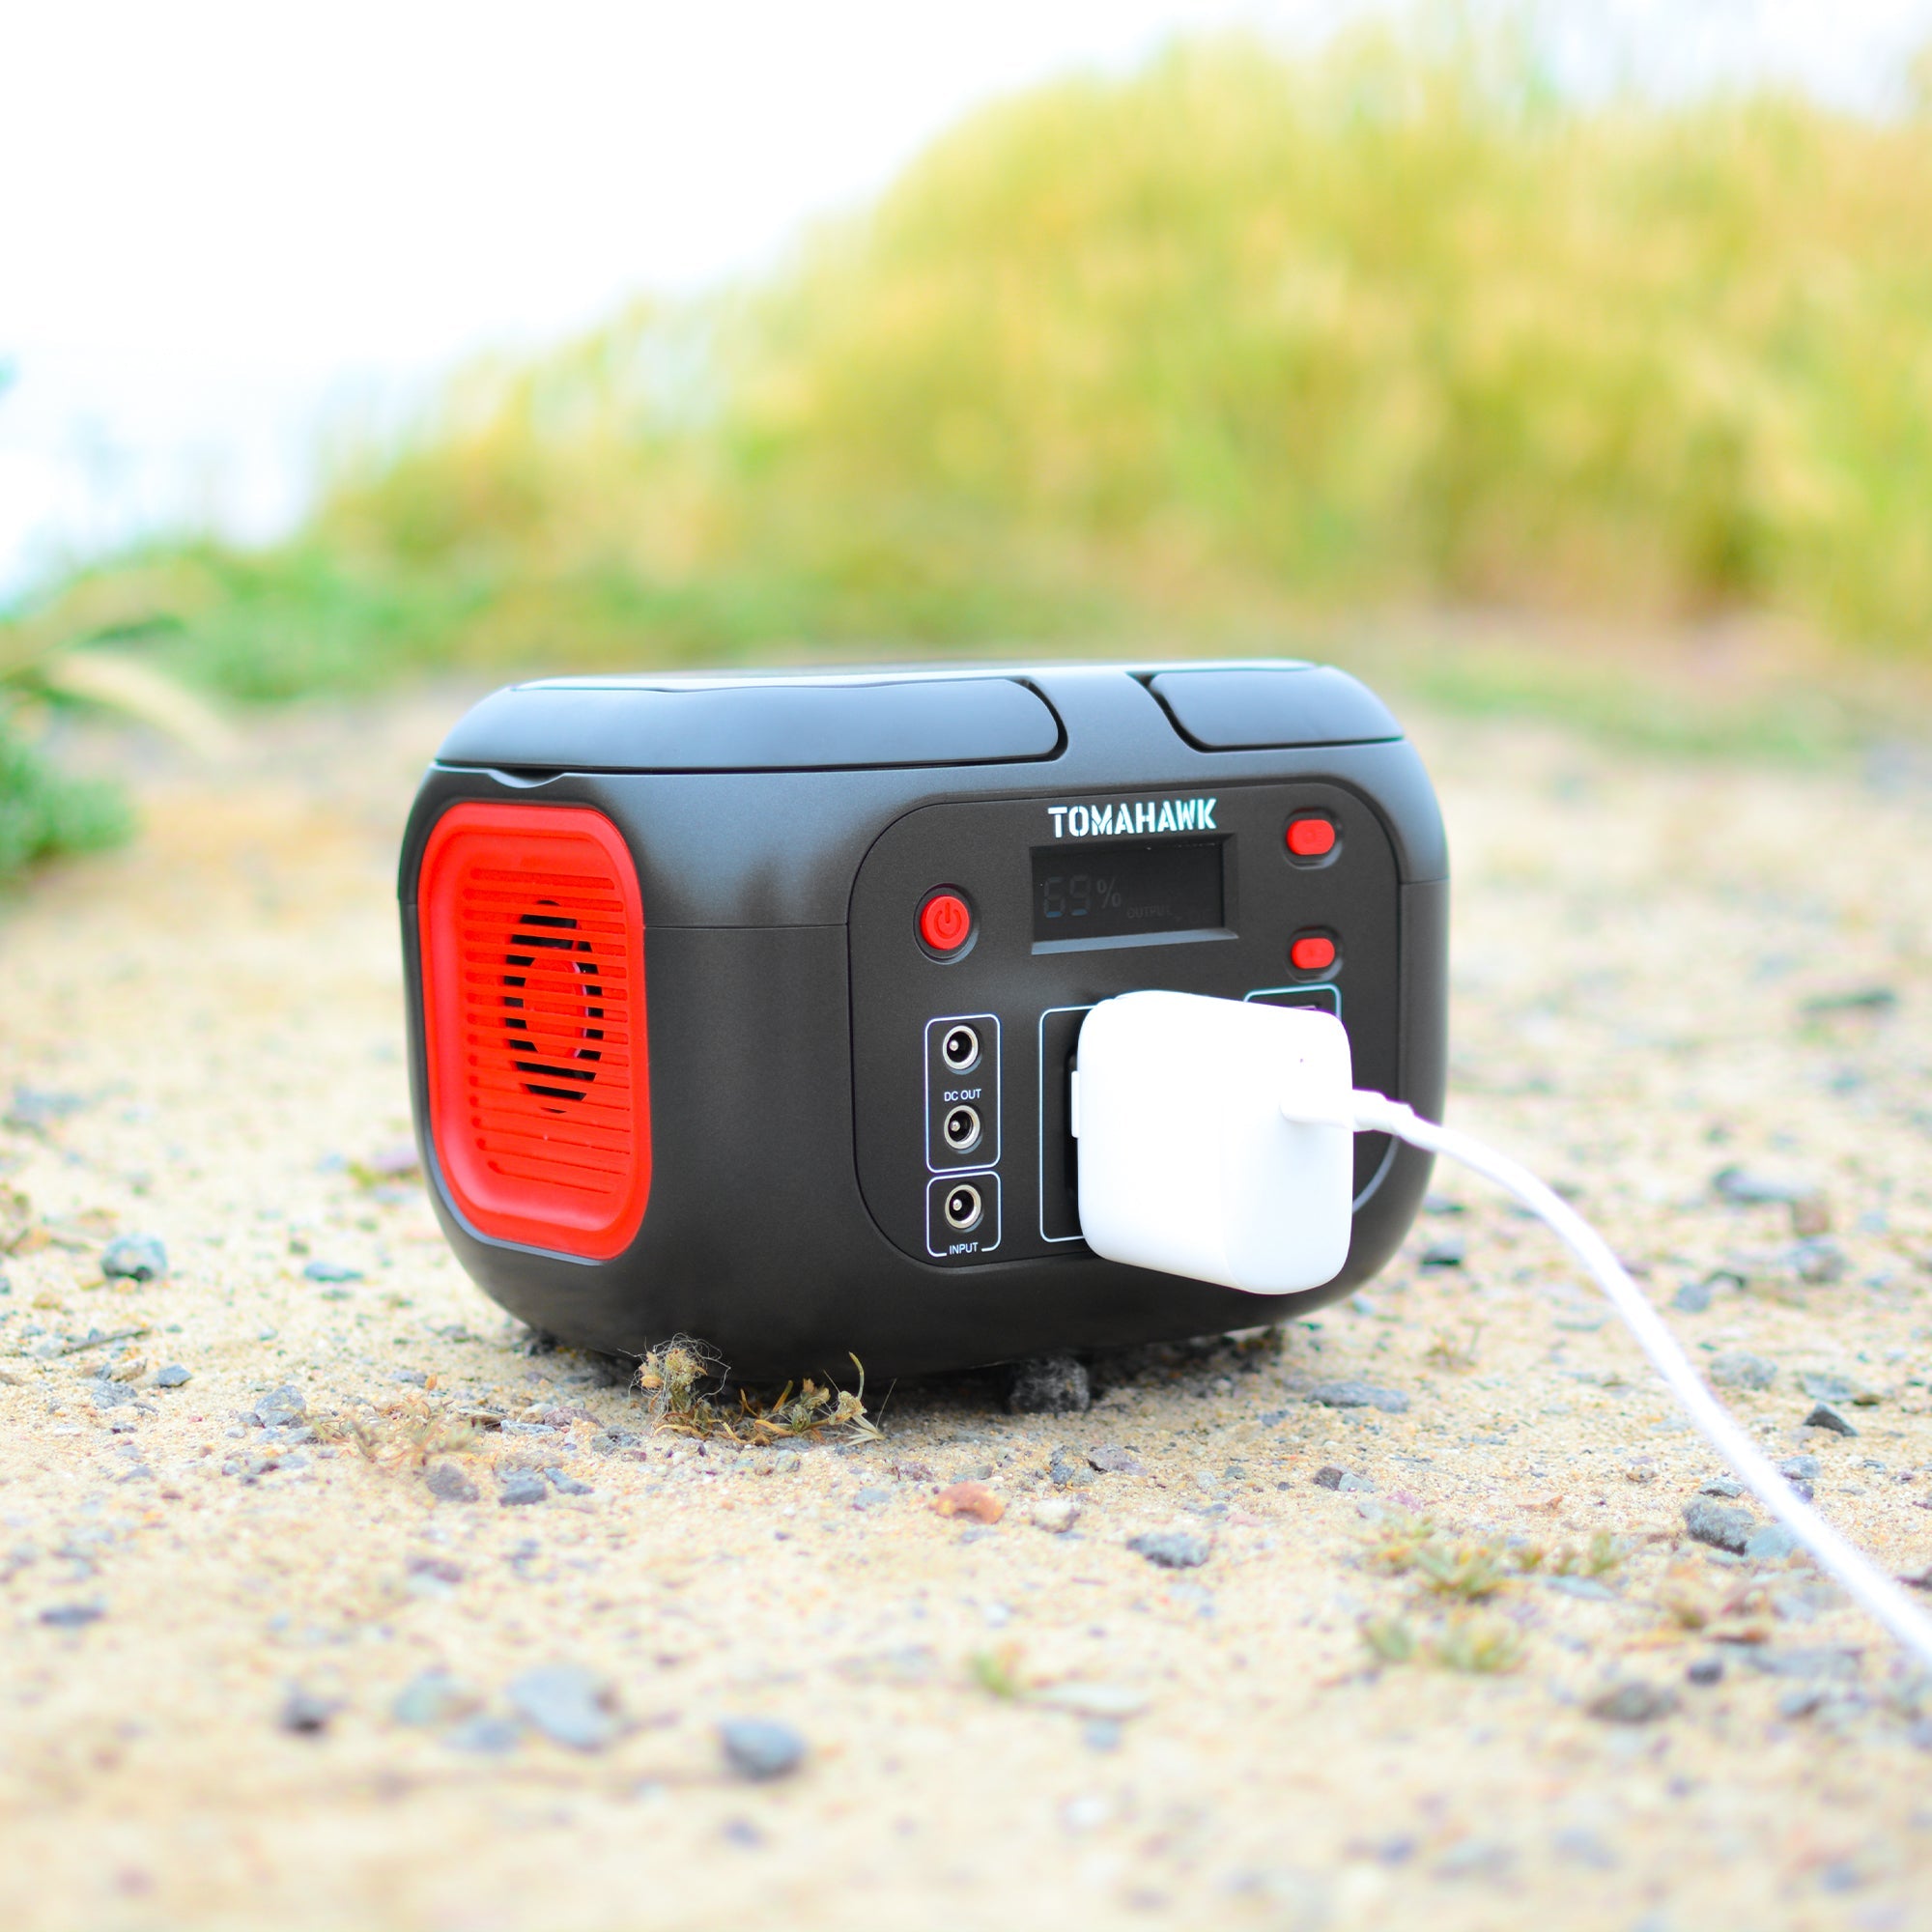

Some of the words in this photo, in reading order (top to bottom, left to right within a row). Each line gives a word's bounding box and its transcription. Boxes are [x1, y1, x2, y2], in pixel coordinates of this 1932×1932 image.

[1047, 799, 1217, 838] TOMAHAWK
[944, 1092, 958, 1101] DC
[960, 1090, 981, 1100] OUT
[949, 1242, 979, 1255] INPUT
